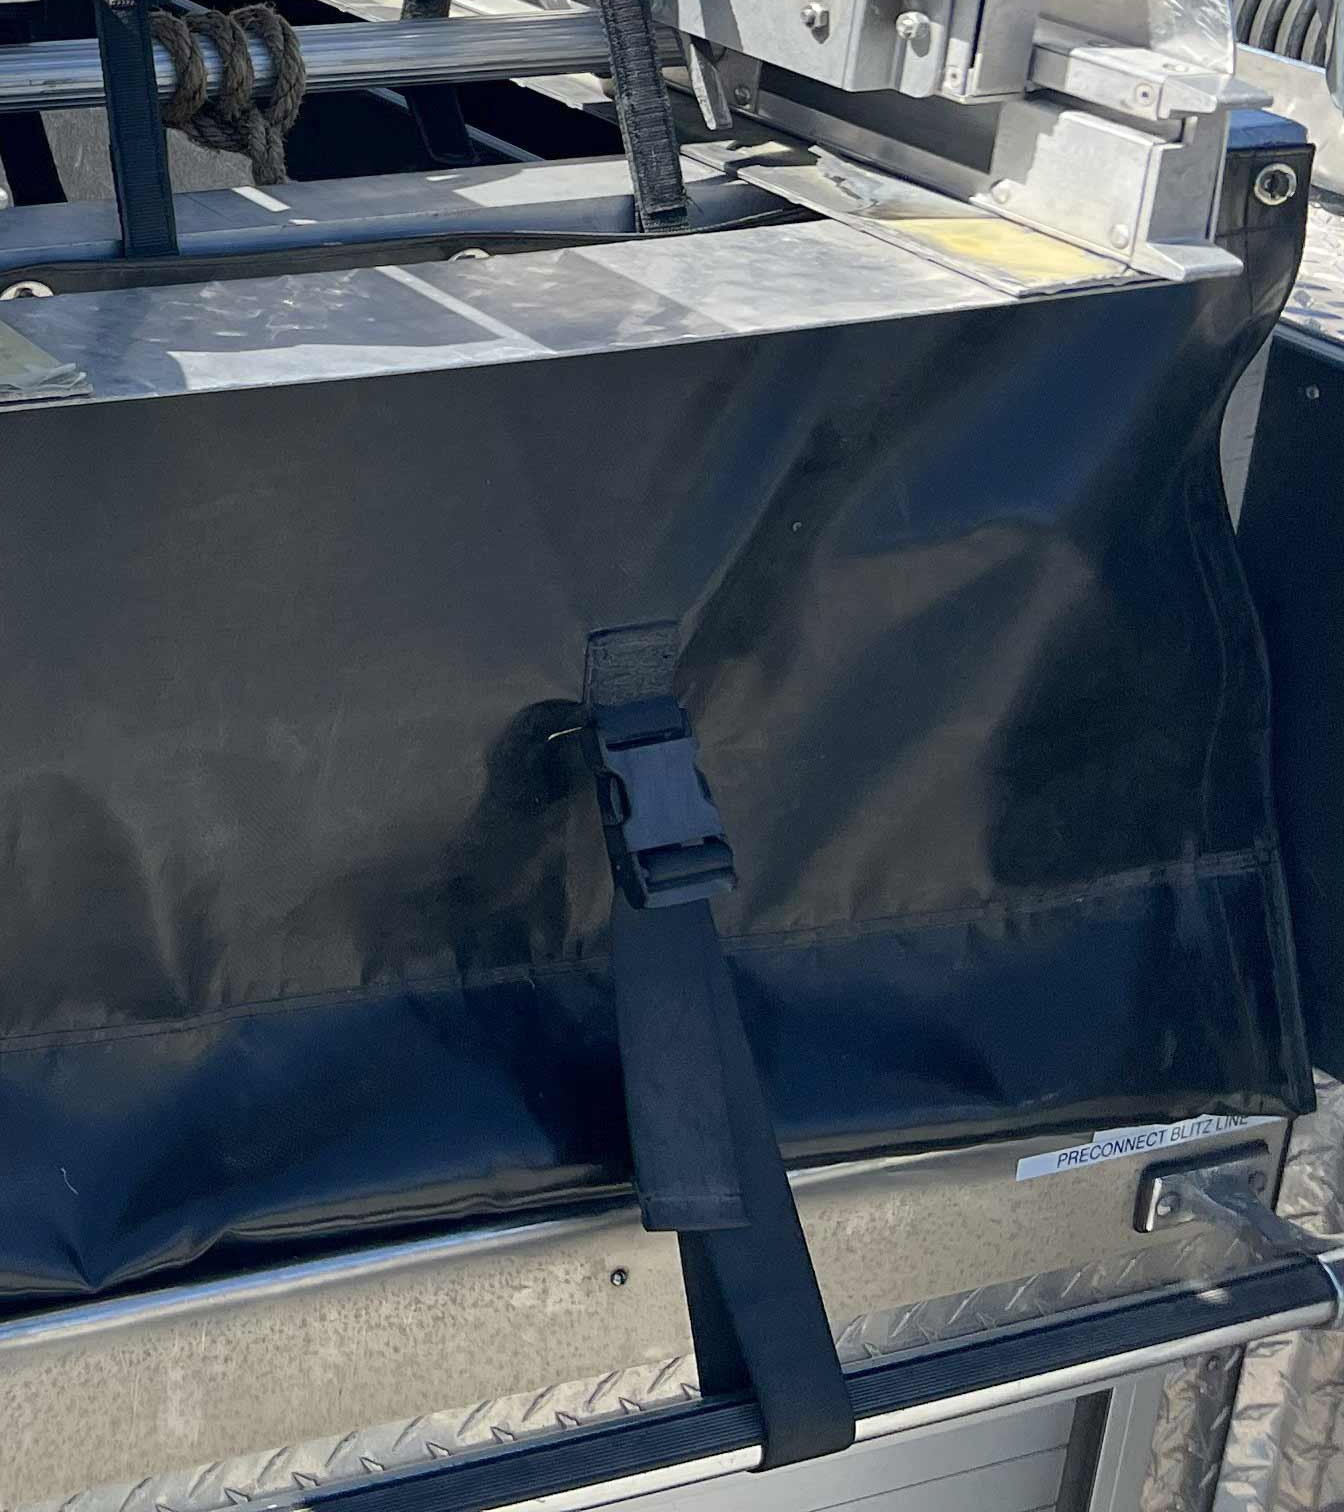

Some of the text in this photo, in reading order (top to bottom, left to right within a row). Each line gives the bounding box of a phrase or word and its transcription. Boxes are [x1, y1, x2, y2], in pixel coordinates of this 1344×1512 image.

[1056, 1113, 1249, 1169] PRECONNECT BLITZ LINE
